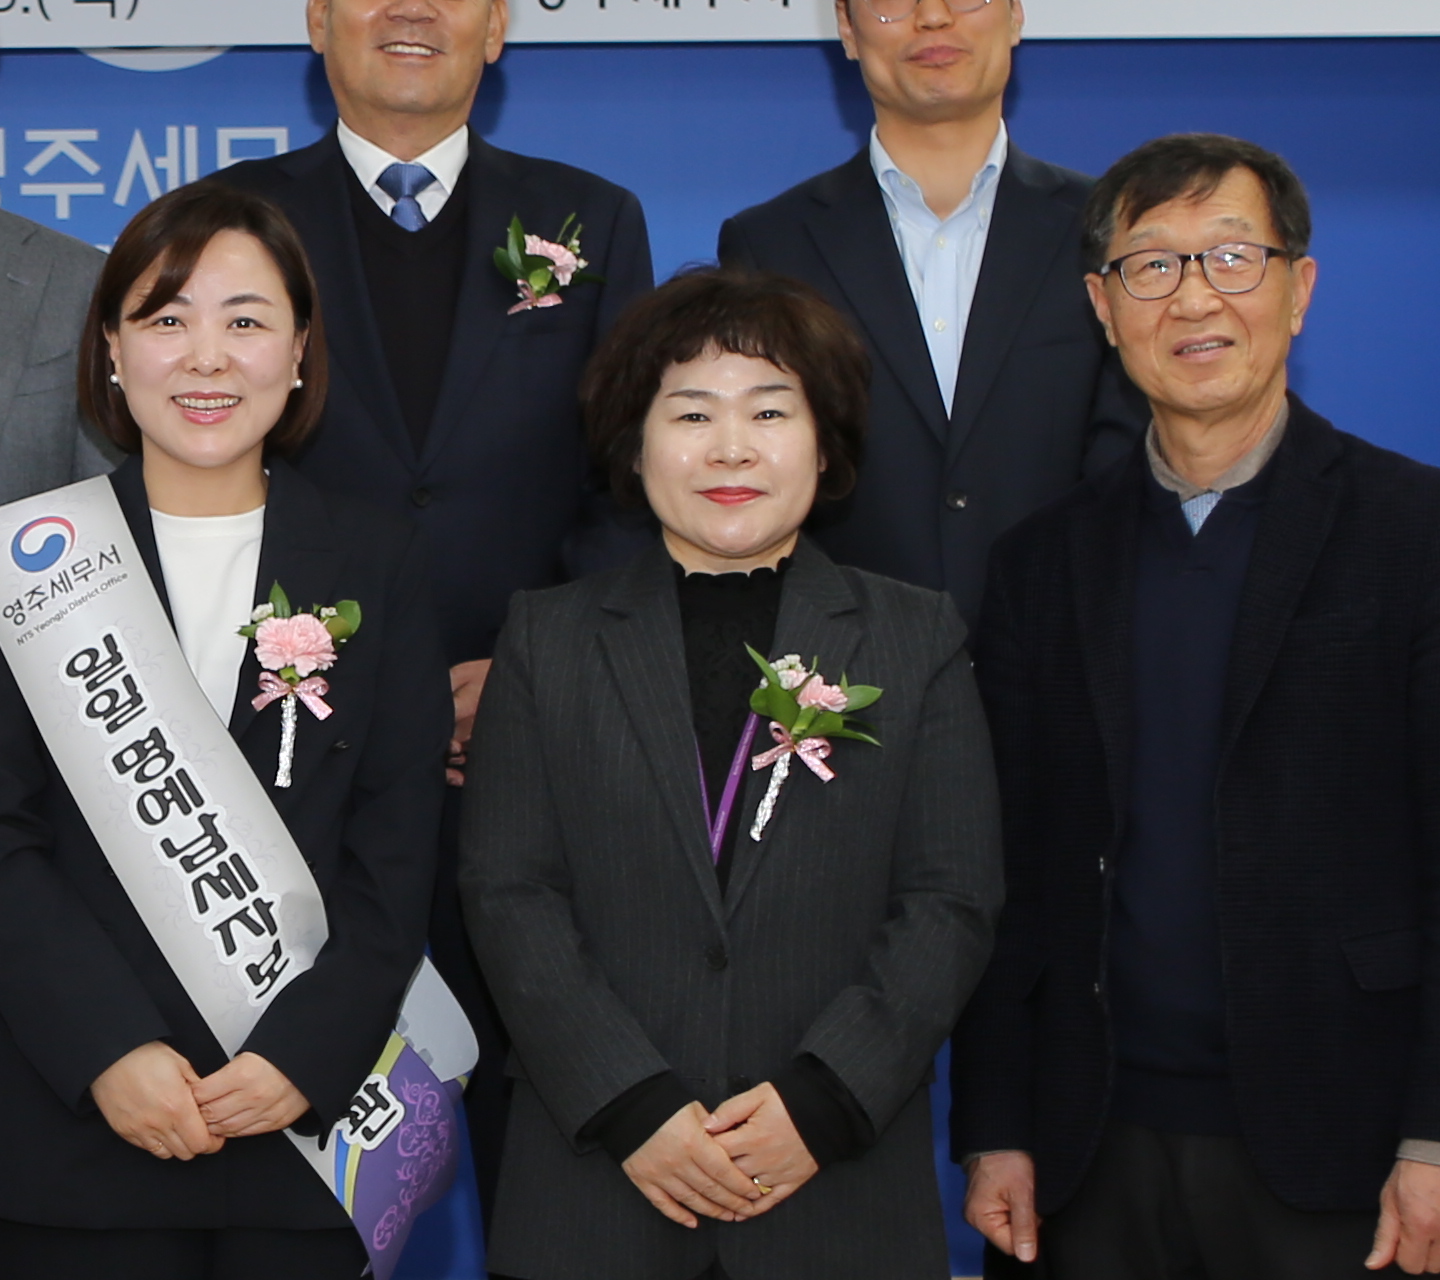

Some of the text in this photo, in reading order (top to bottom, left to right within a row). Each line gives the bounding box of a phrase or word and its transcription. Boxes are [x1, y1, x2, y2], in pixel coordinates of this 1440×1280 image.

[2, 543, 122, 626] 영주세무서
[16, 571, 129, 647] NTS Yeongju District Office
[64, 631, 148, 735] 일일
